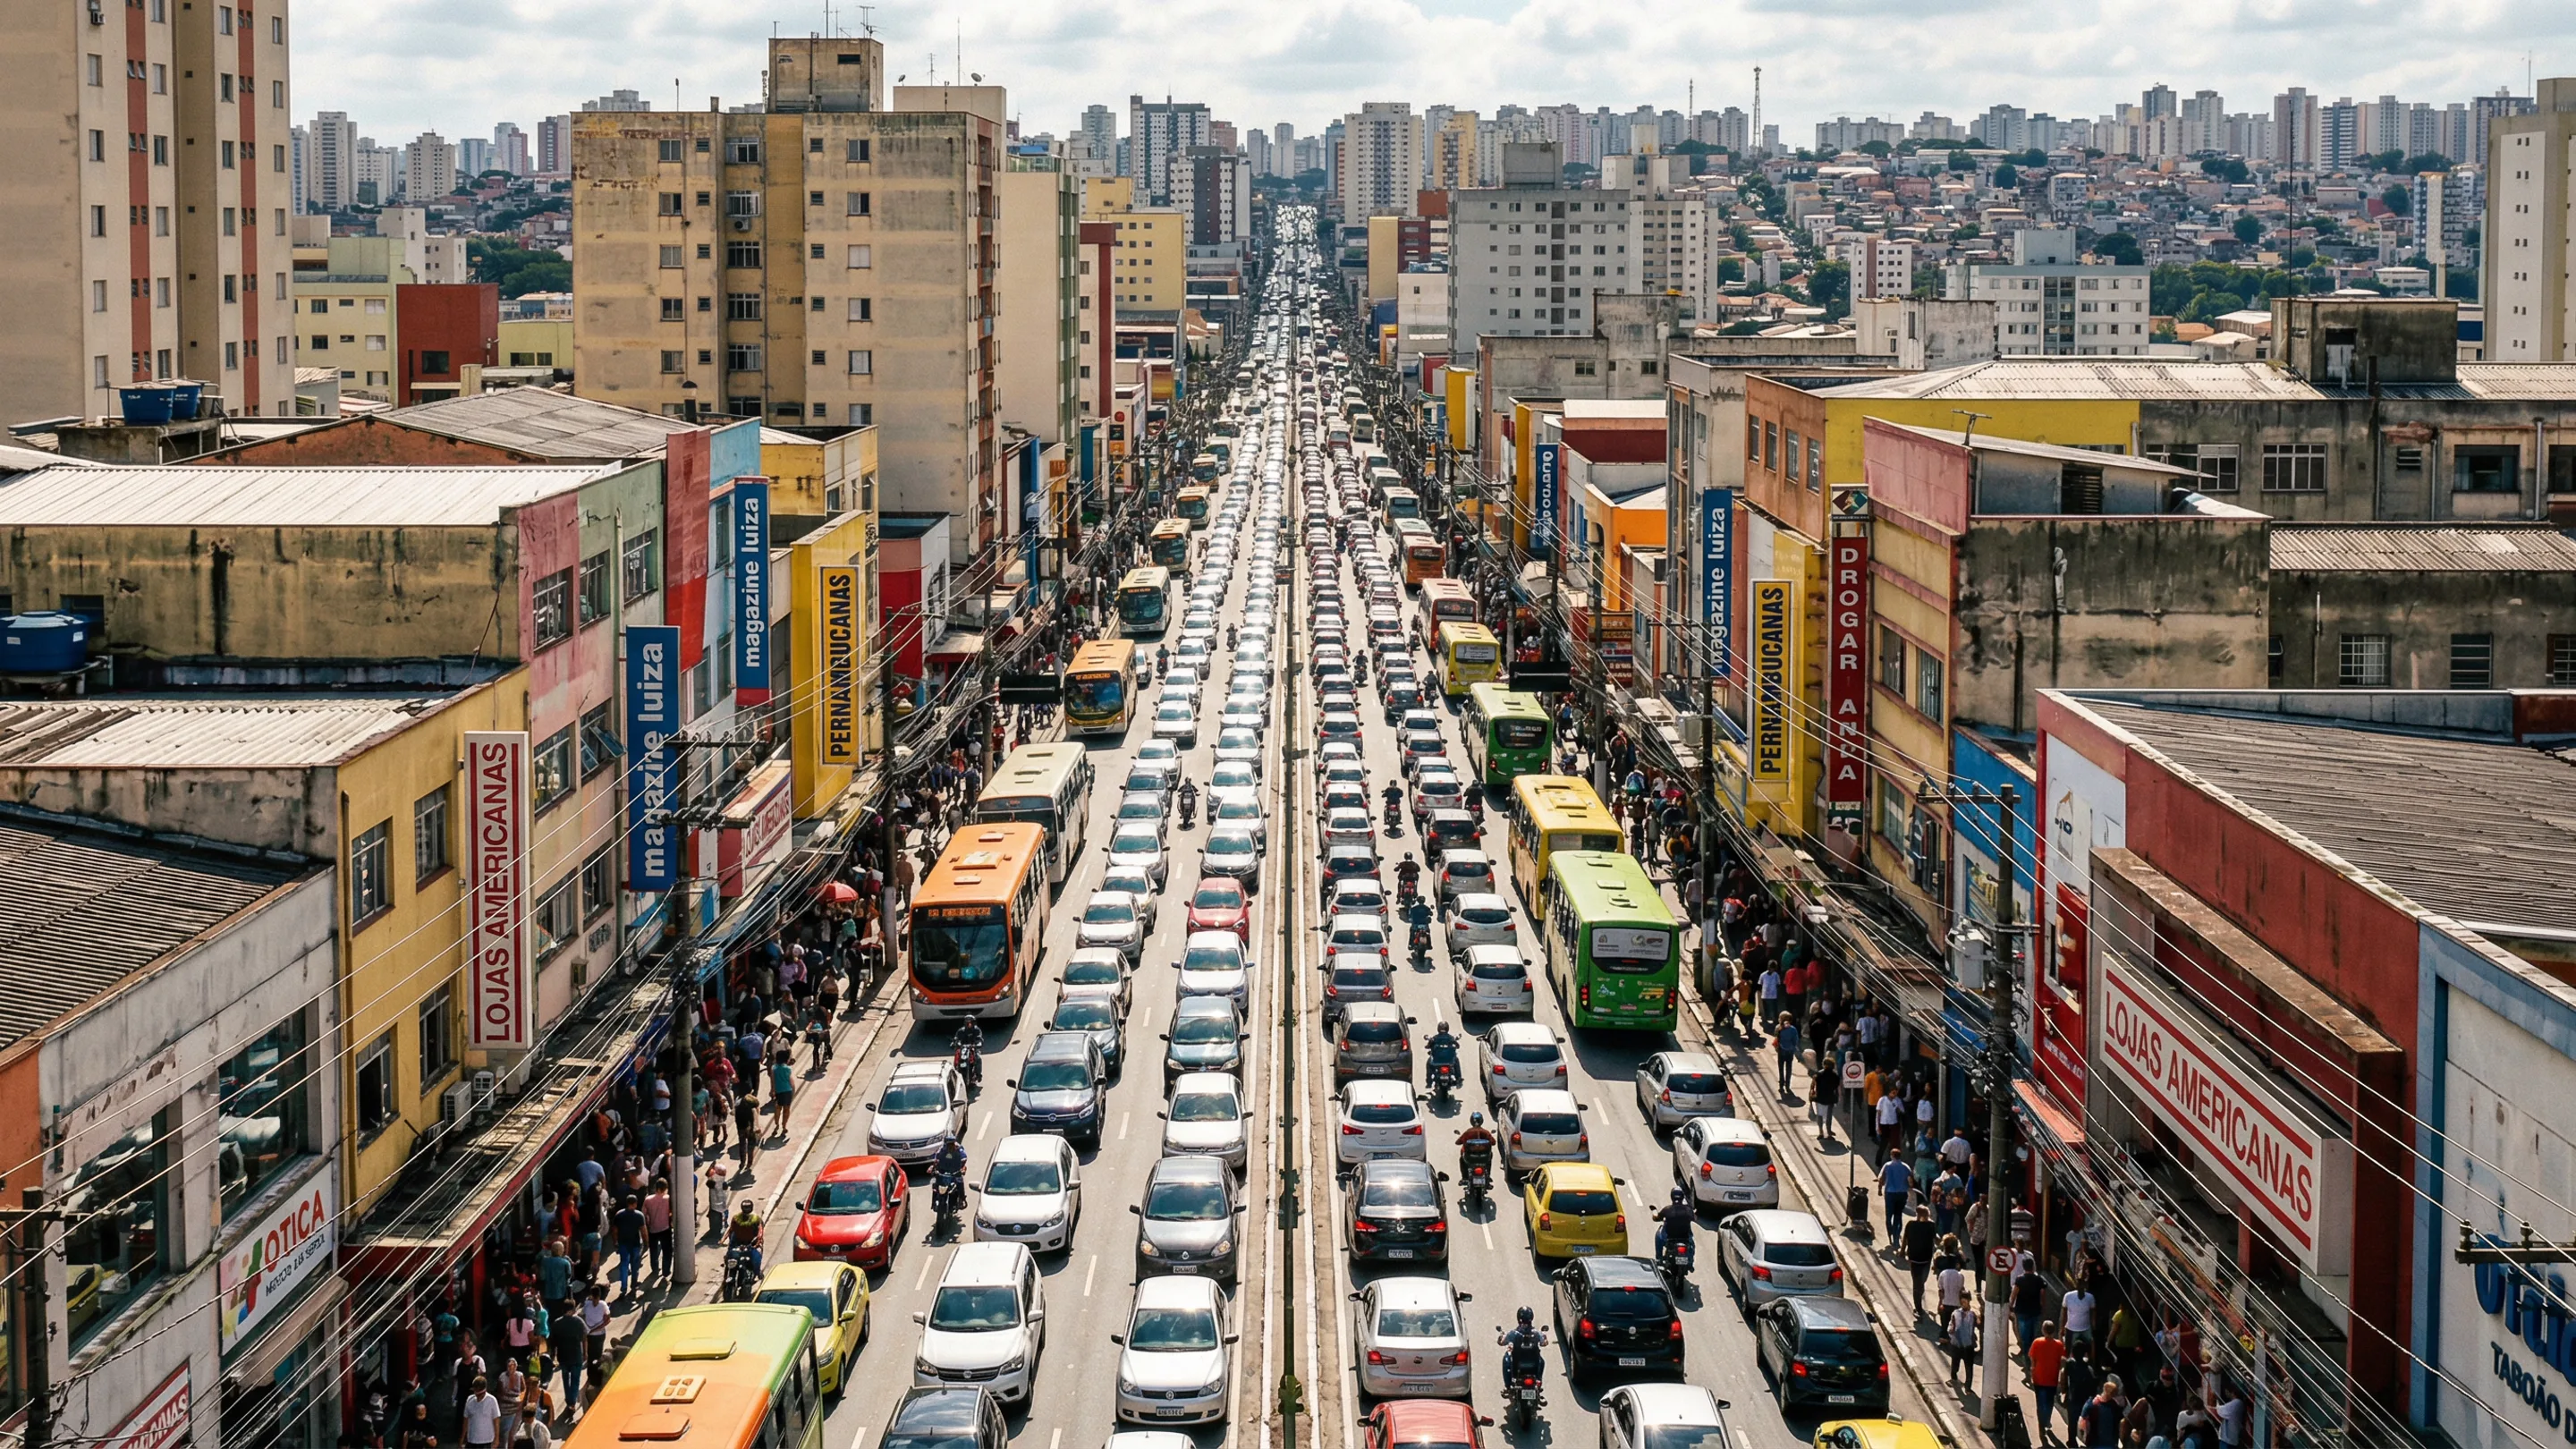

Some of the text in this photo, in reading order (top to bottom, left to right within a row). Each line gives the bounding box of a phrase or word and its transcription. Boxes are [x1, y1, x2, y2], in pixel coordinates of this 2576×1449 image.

[741, 497, 764, 667] magazine luiza
[829, 574, 851, 757] PERNAMBUCANAS
[1707, 507, 1727, 668] magazine luiza
[1839, 547, 1860, 670] DROGAR
[637, 642, 673, 877] magazine luiza
[1760, 588, 1784, 773] PERNAMBUCANAS
[482, 742, 510, 1041] LOJAS AMERICANAS
[2105, 990, 2313, 1222] LOJAS AMERICANAS
[265, 1189, 325, 1273] OTICA
[2491, 1341, 2561, 1428] TABOÃO
